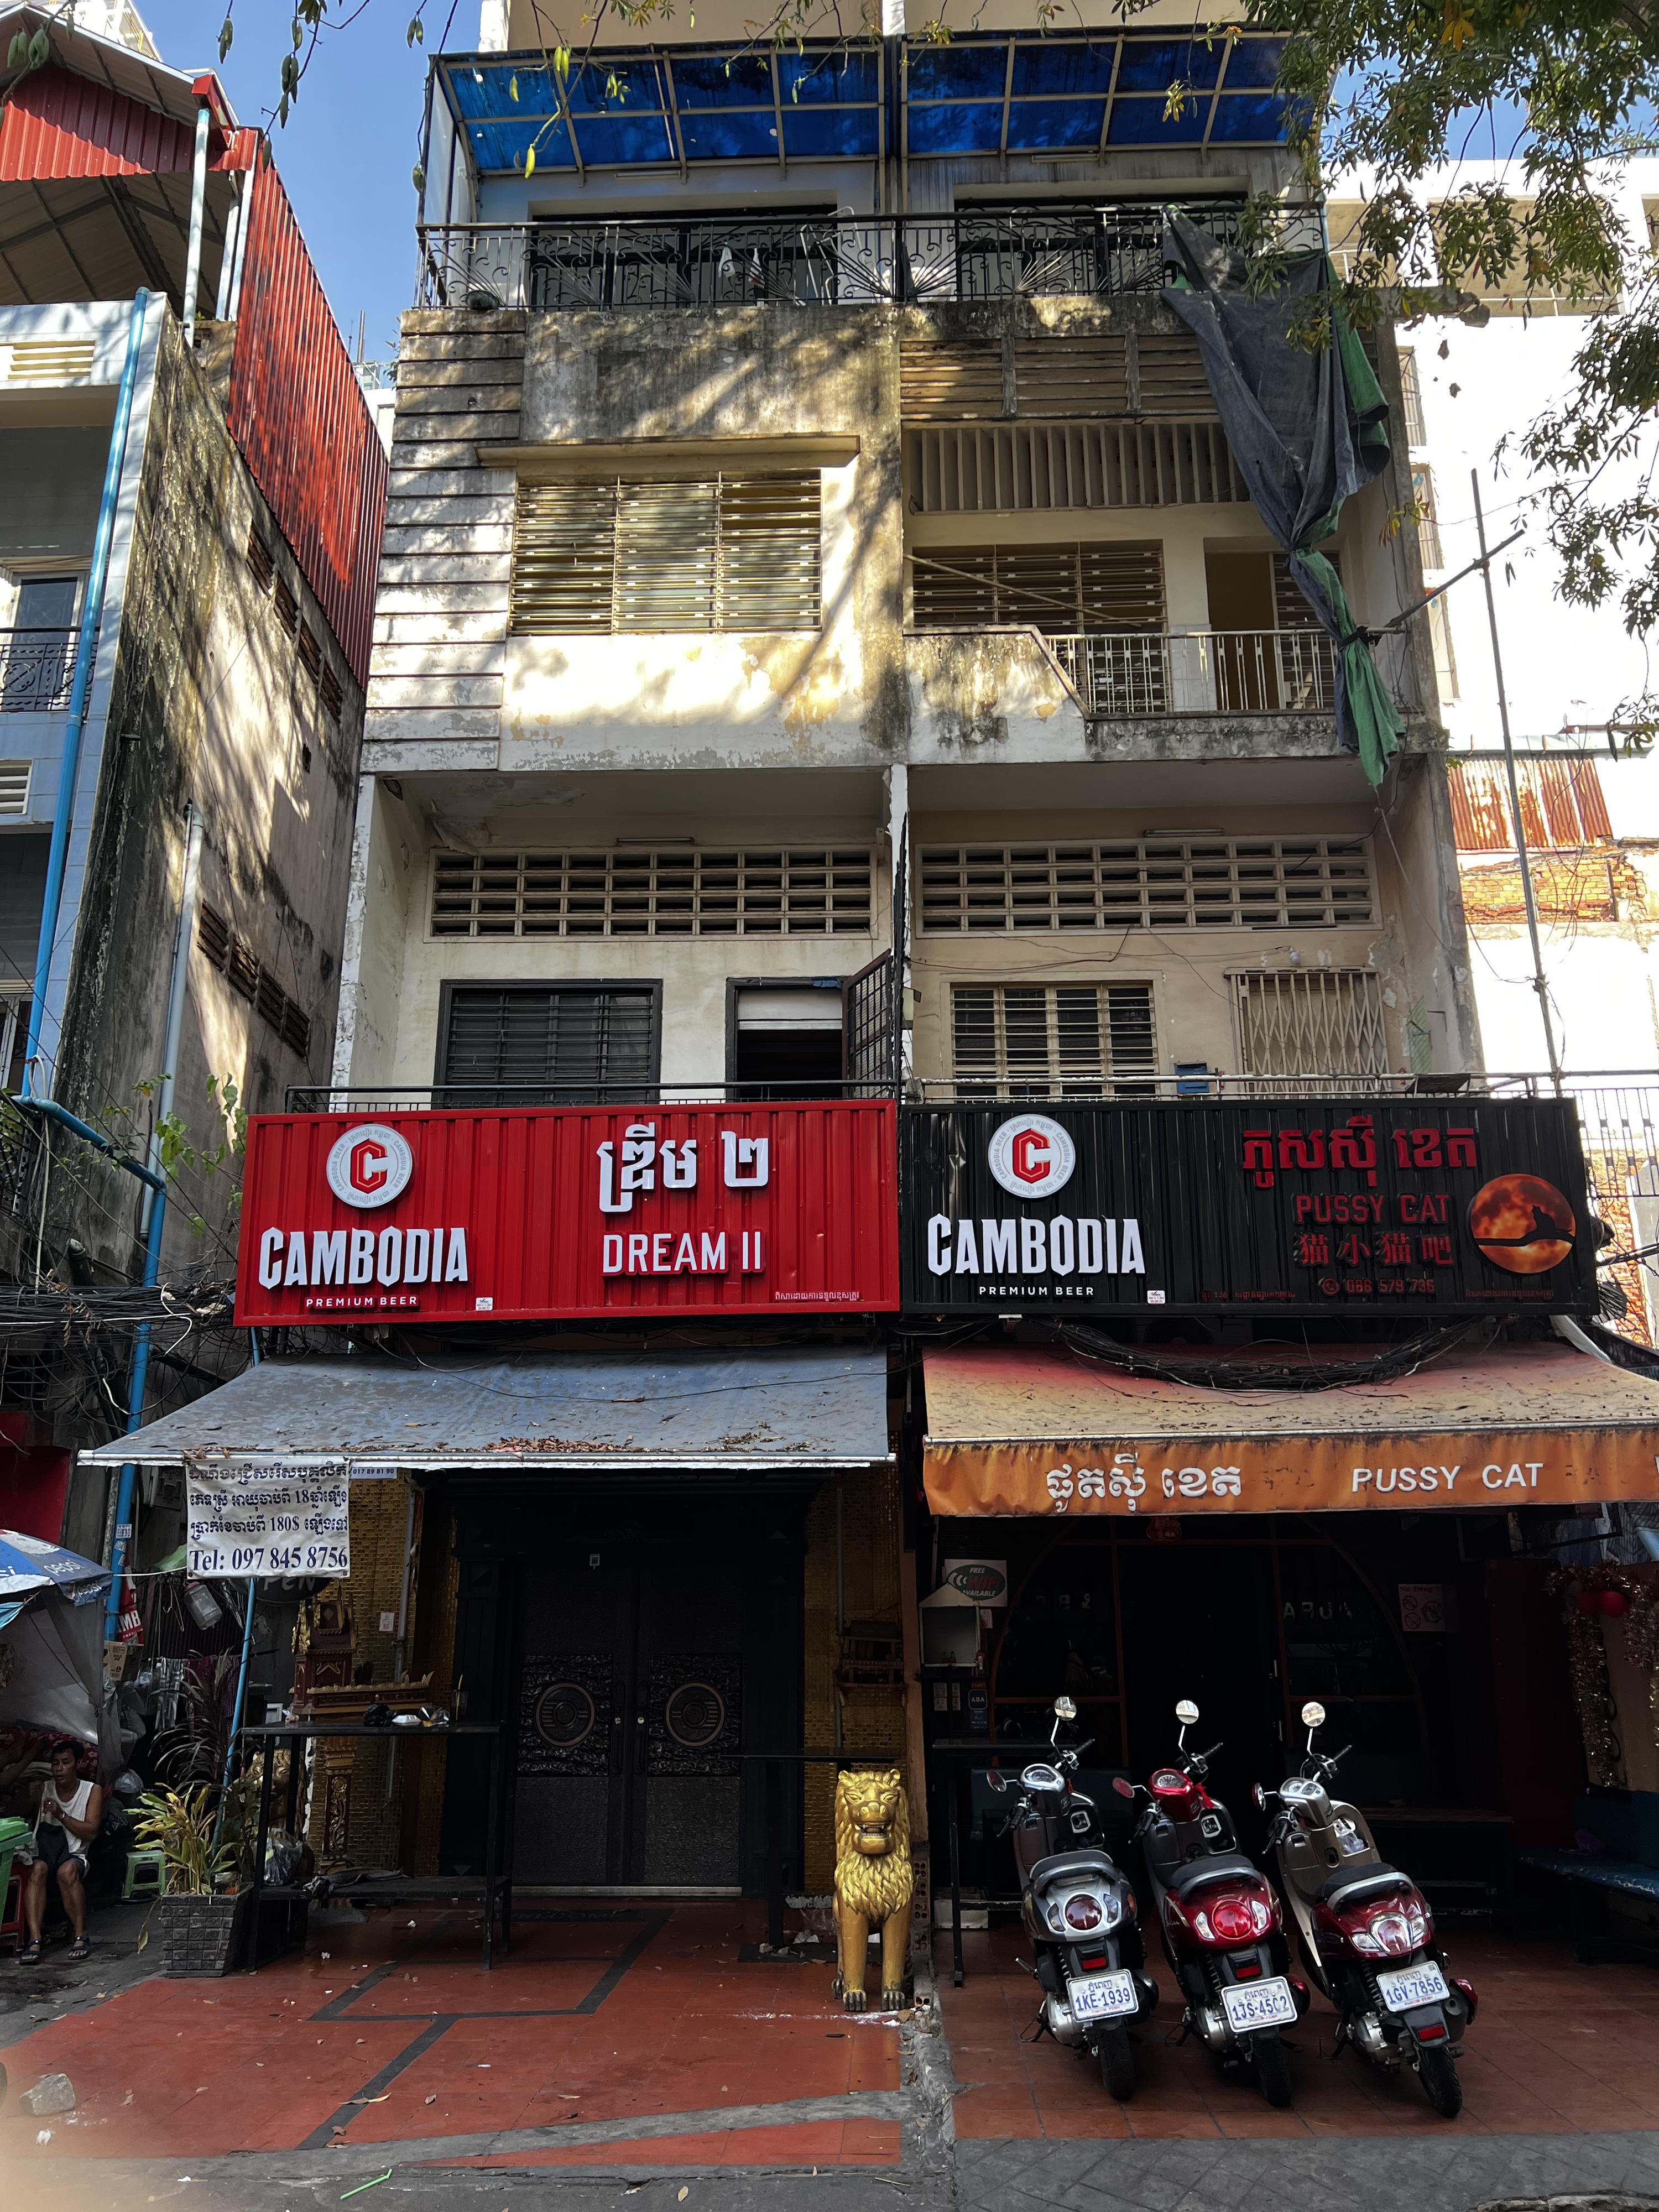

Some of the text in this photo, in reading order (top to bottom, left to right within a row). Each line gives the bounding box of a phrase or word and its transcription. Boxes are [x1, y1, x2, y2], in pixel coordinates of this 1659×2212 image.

[721, 1131, 769, 1187] ២
[994, 1132, 1008, 1180] CAMBODIA BEER
[1056, 1132, 1070, 1180] CAMBODIA BEER
[1393, 1128, 1477, 1168] ខេត
[331, 1143, 346, 1191] CAMBODIA BEER
[393, 1140, 407, 1188] CAMBODIA BEER
[1296, 1194, 1449, 1222] PUSSY CAT
[258, 1225, 468, 1289] CAMBODIA
[603, 1232, 761, 1272] DREAM II
[927, 1213, 1145, 1276] CAMBODIA
[979, 1286, 1094, 1296] PREMIUM BEER
[1346, 1278, 1435, 1293] 086 579 736
[306, 1296, 417, 1307] PREMIUM BEER
[1162, 1466, 1241, 1498] ខេត
[1352, 1465, 1461, 1493] PUSSY
[1482, 1463, 1544, 1489] CAT
[270, 1516, 300, 1532] 180$
[44, 1559, 82, 1577] pepsi
[189, 1546, 348, 1571] Tel: 097 845 8756
[1076, 1987, 1130, 2011] 1KE-1939
[1386, 1976, 1443, 2004] 1GV-7856
